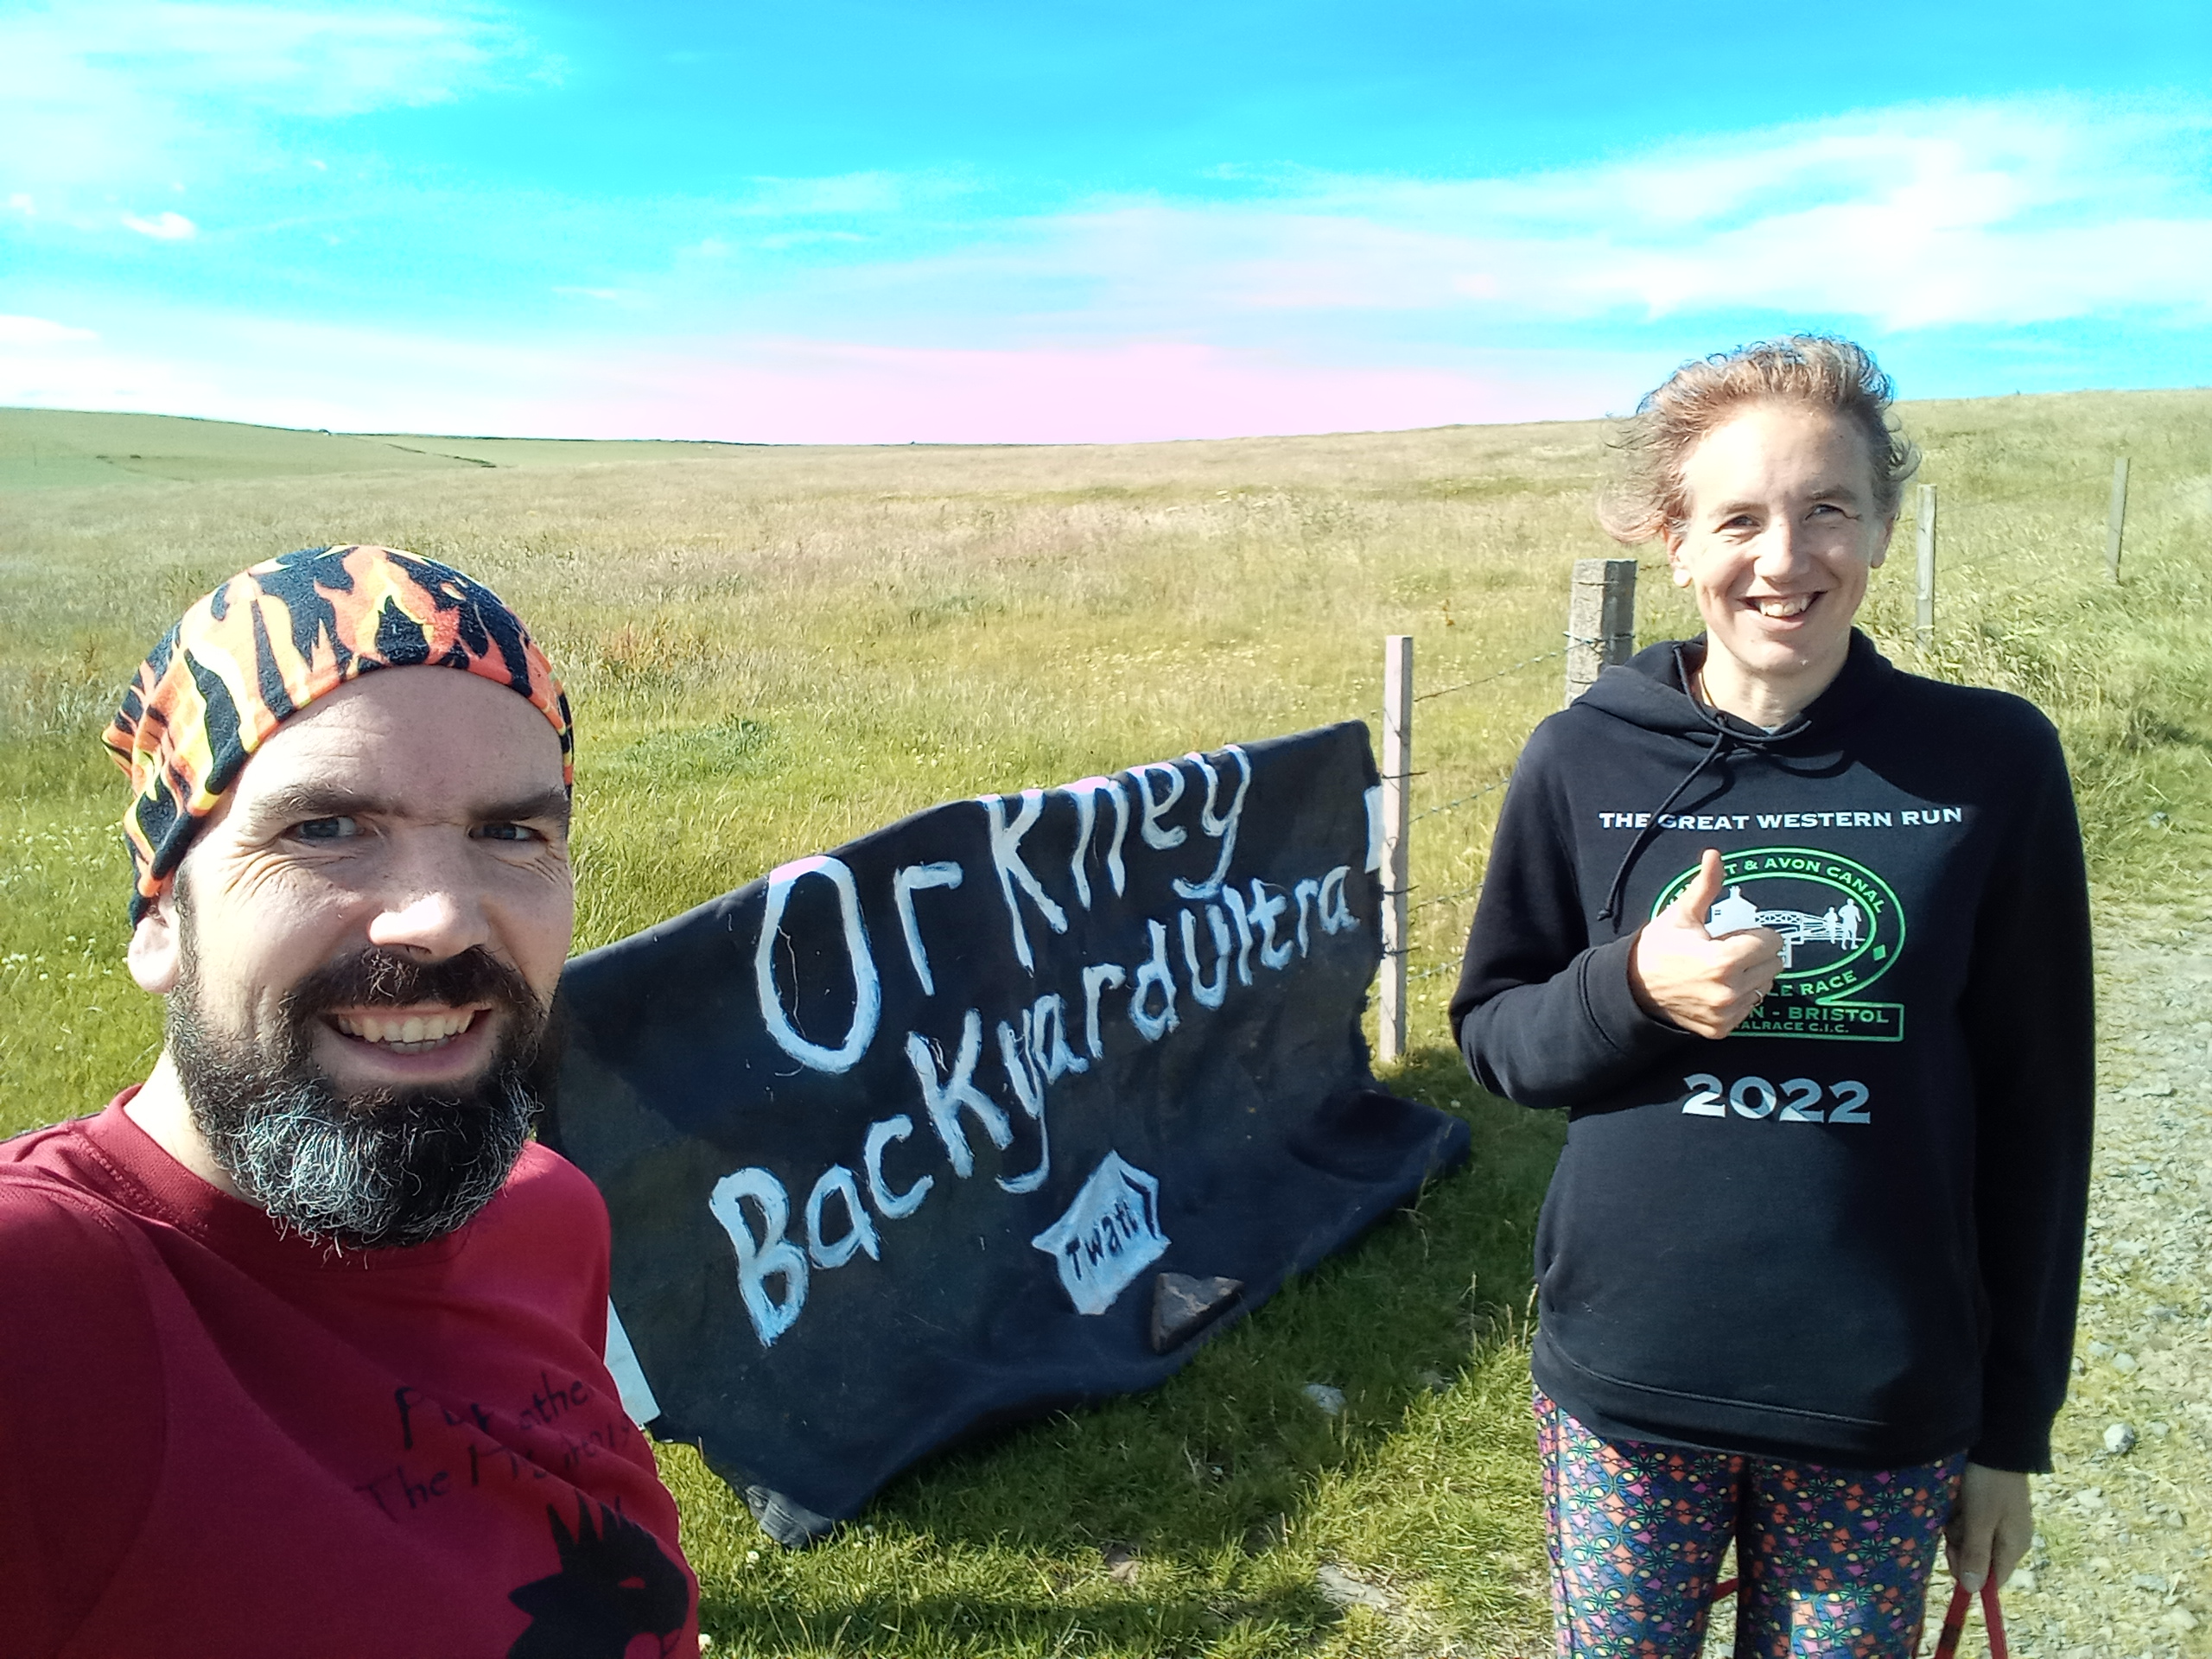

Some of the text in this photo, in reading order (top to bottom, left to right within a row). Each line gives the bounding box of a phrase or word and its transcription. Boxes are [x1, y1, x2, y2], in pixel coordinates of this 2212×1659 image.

[1599, 806, 1962, 830] THE GREAT WESTERN RUN
[1744, 857, 1885, 913] & AVON CANAL
[1800, 970, 1857, 996] RACE
[1735, 1020, 1849, 1033] ALRACE C.I.C.
[1788, 1006, 1889, 1024] BRISTOL
[1681, 1073, 1872, 1124] 2022
[353, 1465, 450, 1523] The
